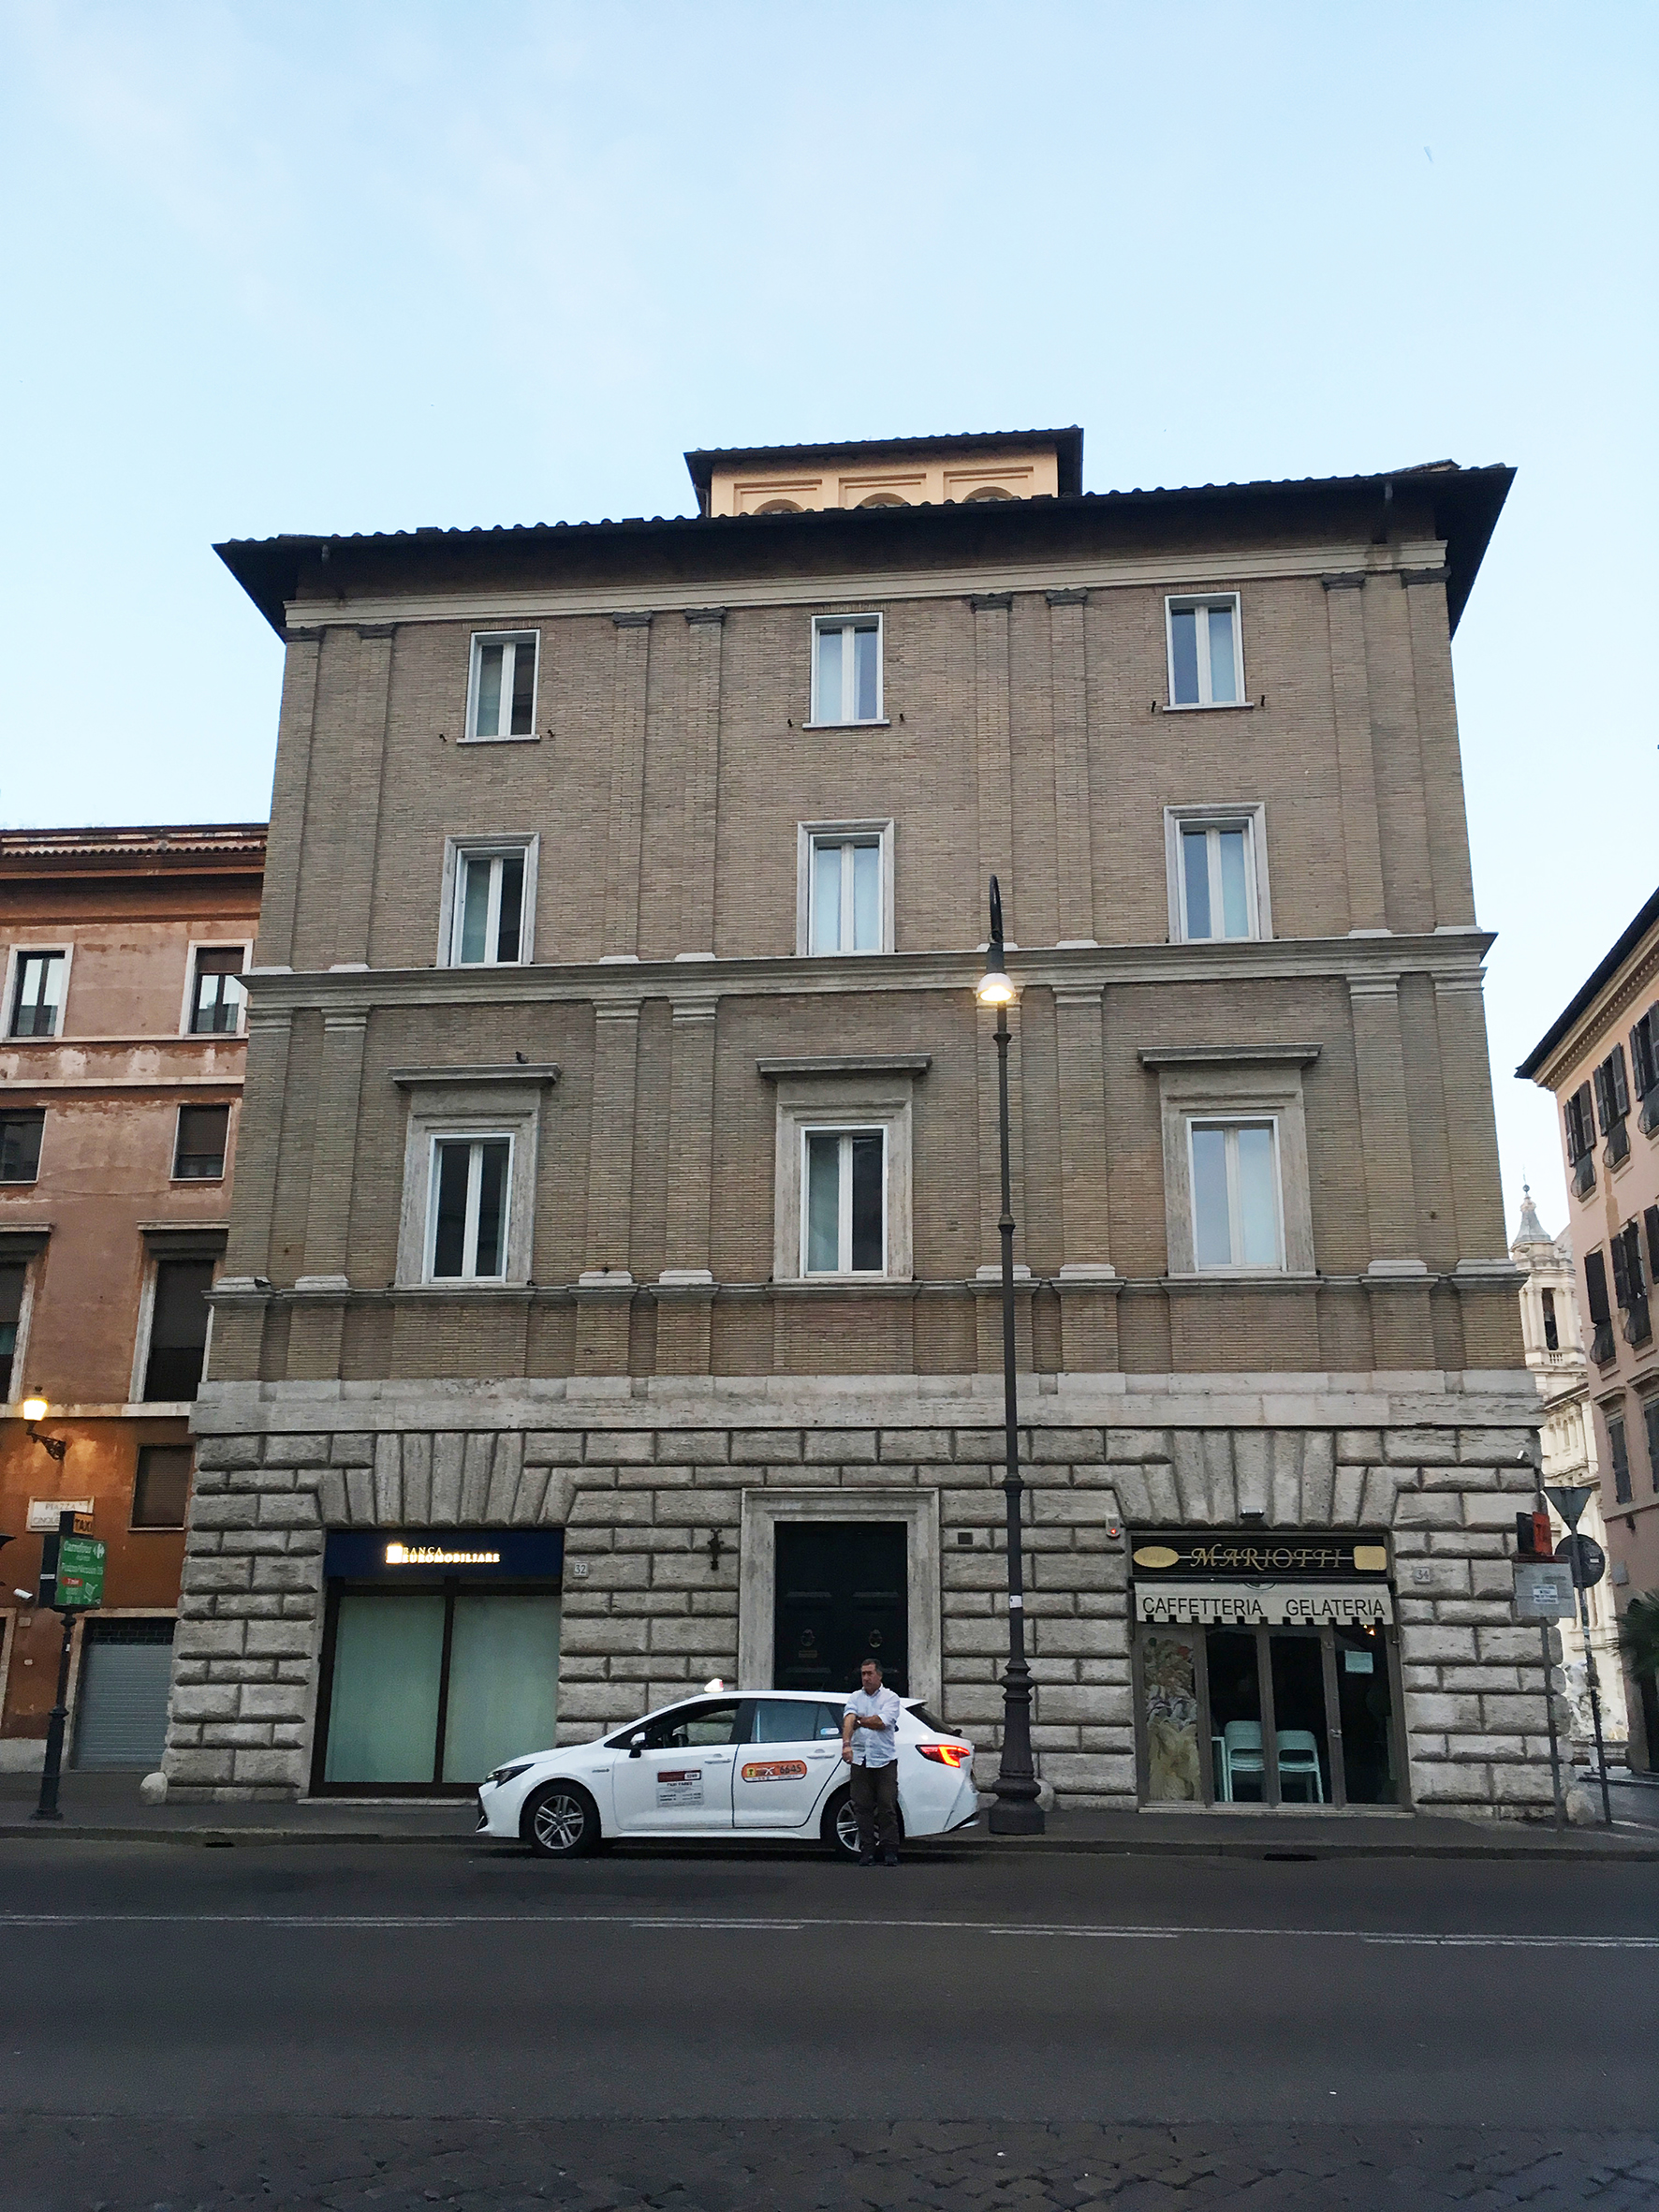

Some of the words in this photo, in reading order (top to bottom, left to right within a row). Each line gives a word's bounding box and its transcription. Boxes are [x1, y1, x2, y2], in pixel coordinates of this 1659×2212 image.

[45, 1502, 76, 1511] PIAZZA
[75, 1518, 93, 1532] TAXI
[404, 1546, 443, 1555] BANCA
[403, 1553, 500, 1563] EUROMOBILIARE
[1190, 1543, 1342, 1571] MARIOTTI
[575, 1564, 586, 1574] 32
[1416, 1570, 1430, 1580] 34
[1142, 1597, 1264, 1615] CAFFETTERIA
[1285, 1599, 1386, 1616] GELATERIA
[779, 1763, 802, 1775] 6645
